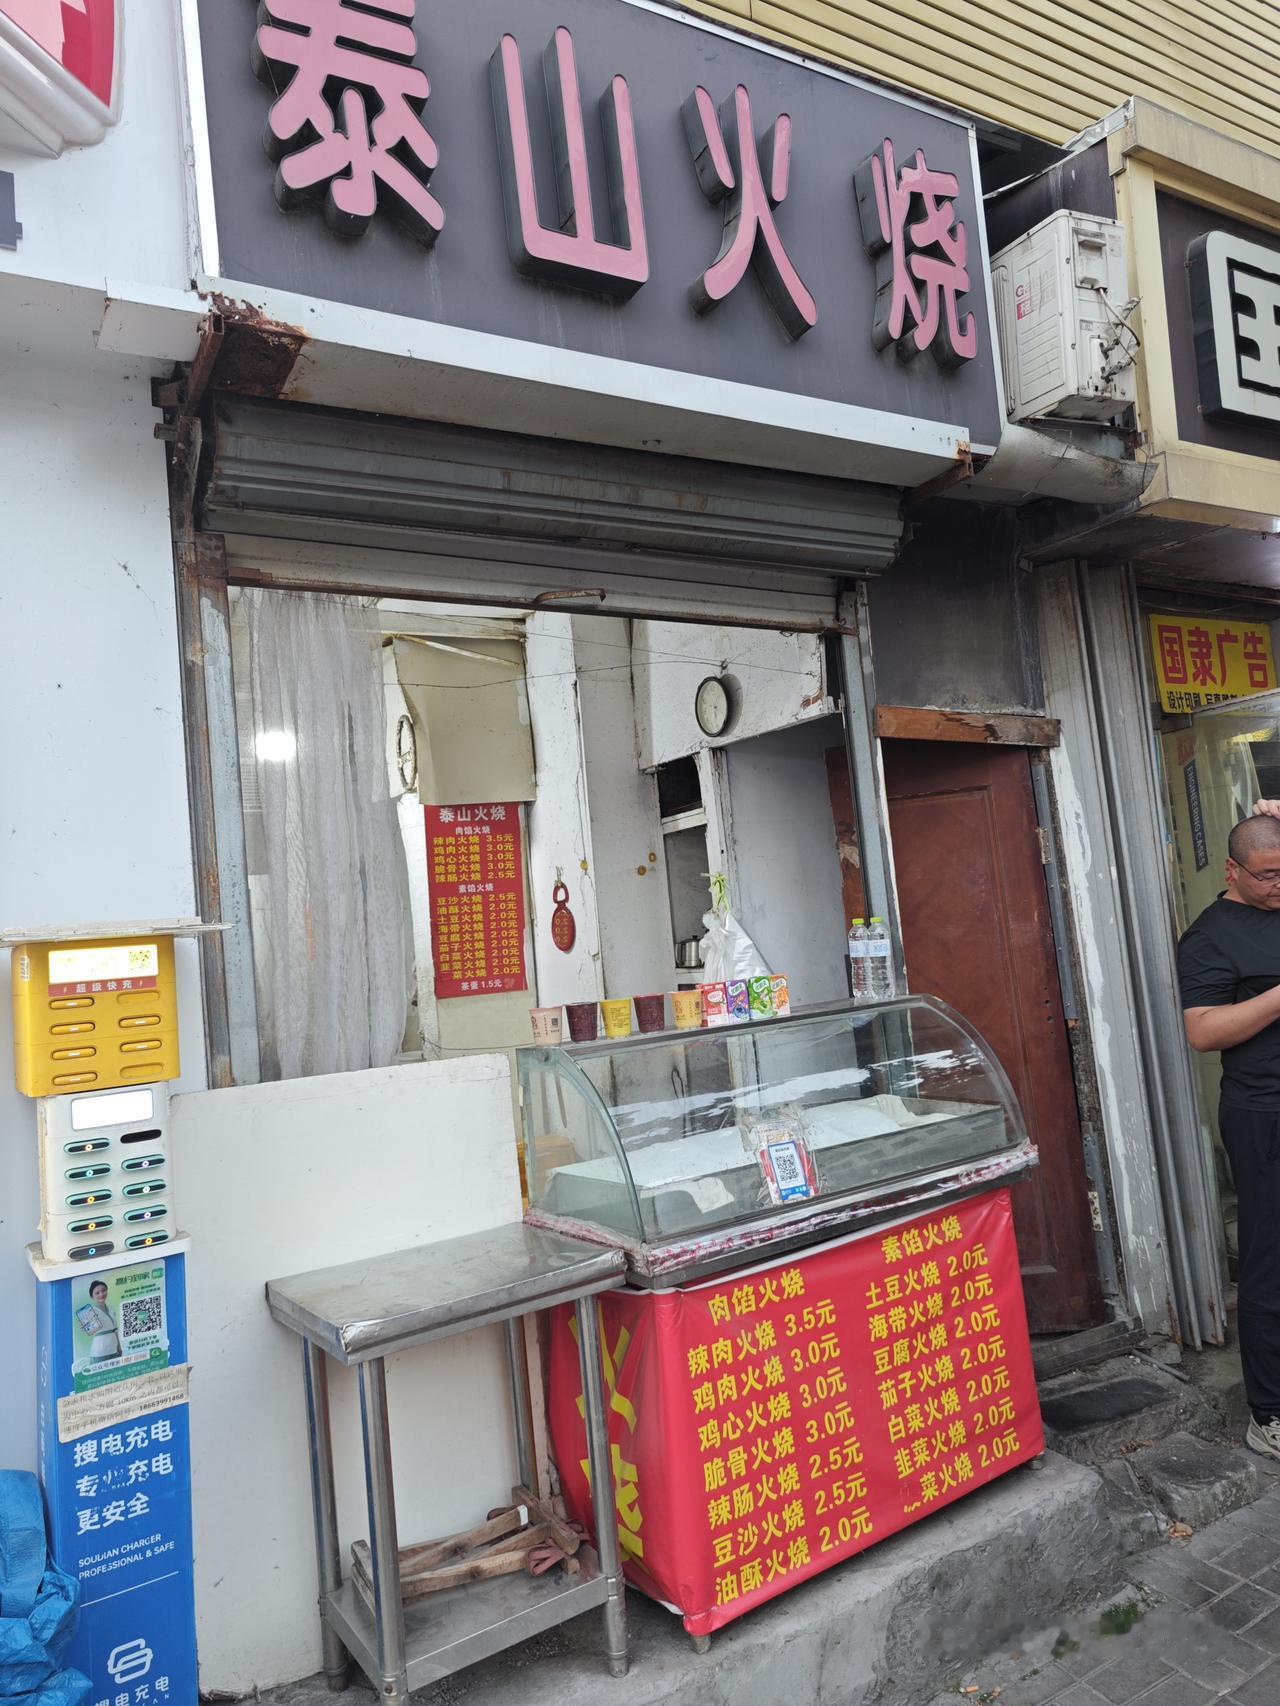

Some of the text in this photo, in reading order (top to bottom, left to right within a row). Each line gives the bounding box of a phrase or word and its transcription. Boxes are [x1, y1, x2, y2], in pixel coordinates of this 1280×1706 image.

[257, 0, 978, 360] 泰山火烧
[1157, 624, 1268, 688] 国隶广告
[439, 806, 507, 824] 泰山火烧
[455, 826, 490, 836] 肉馅火烧
[486, 834, 514, 843] 3.5元
[486, 843, 514, 852] 3.0元
[486, 853, 515, 861] 3.0元
[487, 862, 515, 870] 3.0元
[487, 871, 516, 880] 2.5元
[436, 893, 517, 906] 豆沙火烧 2.5元
[437, 912, 518, 924] 土豆火烧 2.0元
[489, 902, 517, 911] 2.0元
[490, 921, 518, 930] 2.0元
[490, 930, 519, 938] 2.0元
[491, 939, 519, 947] 2.0元
[491, 948, 520, 957] 2.0元
[492, 957, 520, 966] 2.0元
[492, 966, 521, 976] 2.0元
[76, 980, 133, 993] 超级快充
[881, 1215, 963, 1264] 素馅火烧
[708, 1268, 805, 1326] 肉馅火烧
[865, 1243, 988, 1310] 土豆火烧 2.0元
[868, 1273, 994, 1342] 海带火烧 2.0元
[687, 1298, 836, 1379] 辣肉火烧 3.5元
[873, 1303, 1000, 1376] 豆腐火烧 2.0元
[692, 1332, 840, 1415] 鸡肉火烧 3.0元
[878, 1334, 1006, 1411] 茄子火烧 2.0元
[697, 1366, 847, 1453] 鸡心火烧 3.0元
[888, 1365, 1011, 1444] 白菜火烧 2.0元
[74, 1419, 174, 1468] 搜电充电
[703, 1401, 855, 1493] 脆骨火烧 3.0元
[894, 1396, 1016, 1480] 韭菜火烧 2.0元
[707, 1436, 864, 1531] 辣肠火烧 2.5元
[904, 1427, 1020, 1513] 菜火烧 2.0元
[76, 1491, 150, 1536] 更安全
[712, 1471, 868, 1569] 豆沙火烧 2.5元
[78, 1541, 176, 1581] PROFESSIONAL & SAFE
[120, 1533, 162, 1553] CHARGER
[715, 1505, 873, 1607] 油酥火烧 2.0元
